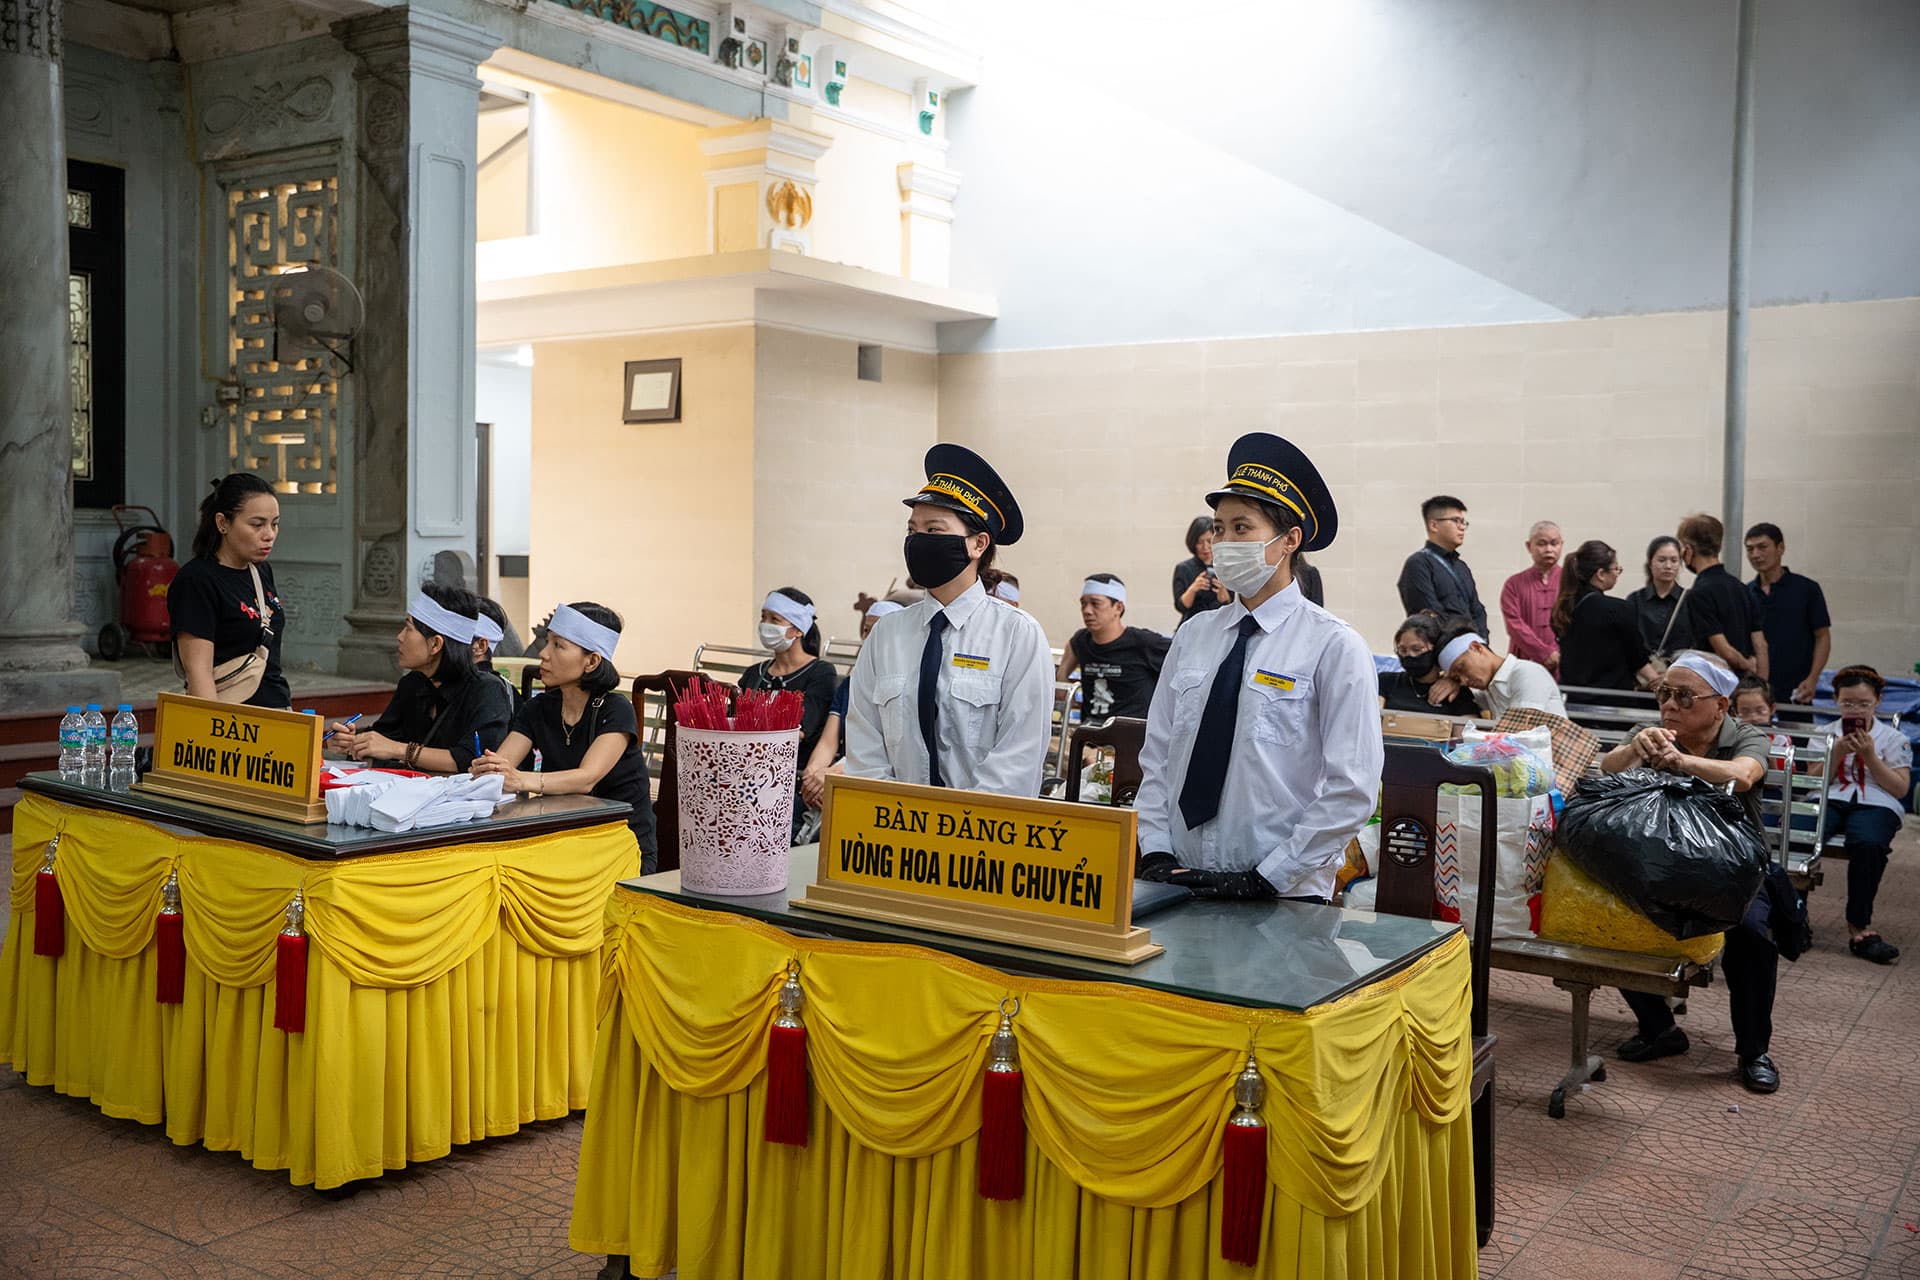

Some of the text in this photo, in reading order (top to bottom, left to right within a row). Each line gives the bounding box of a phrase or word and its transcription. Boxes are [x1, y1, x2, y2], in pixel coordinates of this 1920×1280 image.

[210, 715, 260, 744] BÀN
[173, 738, 295, 788] ĐĂNG KÝ VIẾNG
[873, 801, 1068, 852] BÀN ĐĂNG KÝ
[840, 831, 1103, 910] VÒNG HOA LUÂN CHUYỂN
